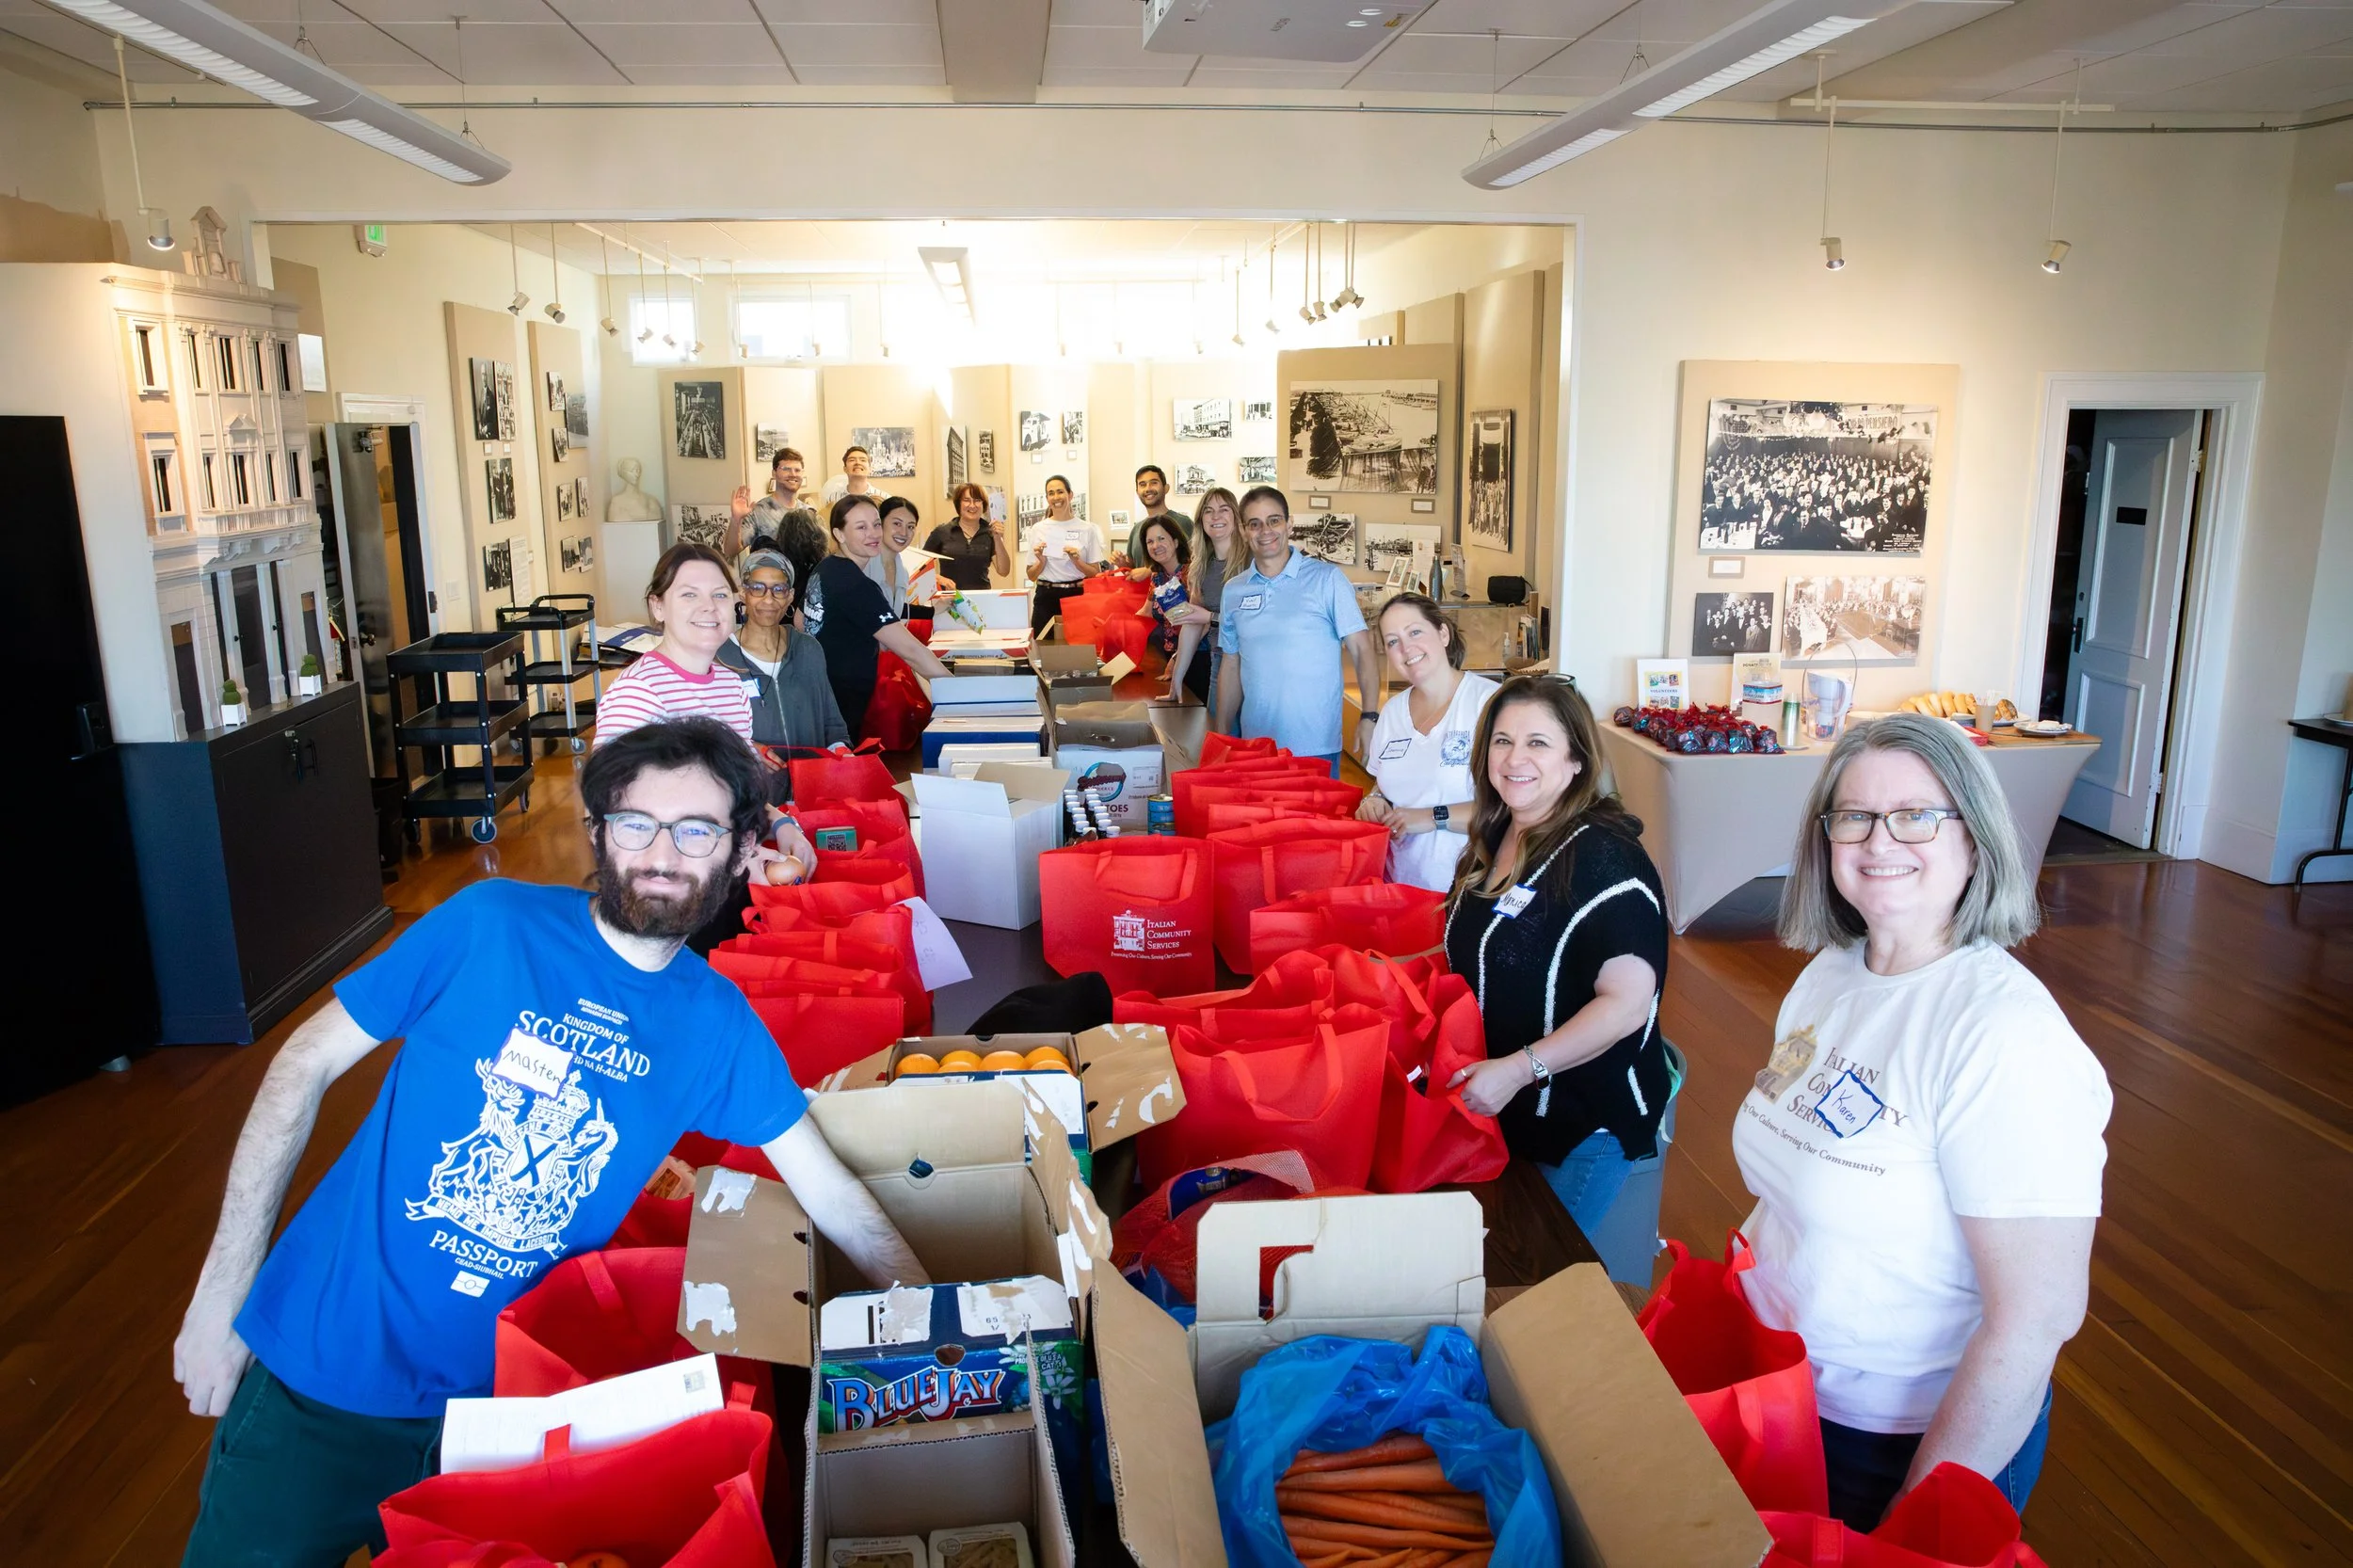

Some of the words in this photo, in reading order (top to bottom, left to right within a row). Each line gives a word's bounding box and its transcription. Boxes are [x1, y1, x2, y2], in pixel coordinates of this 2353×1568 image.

[1146, 919, 1176, 928] ITALIAN
[1146, 929, 1192, 938] COMMUNITY
[1146, 940, 1180, 950] SERVICES
[578, 998, 612, 1016] EUROPEAN
[519, 1010, 650, 1077] SCOTLAND
[562, 1013, 615, 1040] KINGDOM
[614, 1032, 630, 1045] OF
[584, 1059, 595, 1070] NA
[595, 1064, 628, 1083] H-ALBA
[1786, 1094, 1834, 1133] SERVIC
[1832, 1089, 1857, 1125] Karen
[1748, 1105, 1760, 1118] Our
[1780, 1128, 1802, 1151] Serving
[1802, 1141, 1818, 1155] Our
[1818, 1149, 1886, 1176] Community
[436, 1198, 462, 1219] NEMO
[463, 1214, 478, 1230] ME
[480, 1225, 517, 1249] IMPUNE
[520, 1234, 554, 1249] LACESSIT
[428, 1229, 538, 1278] PASSPORT
